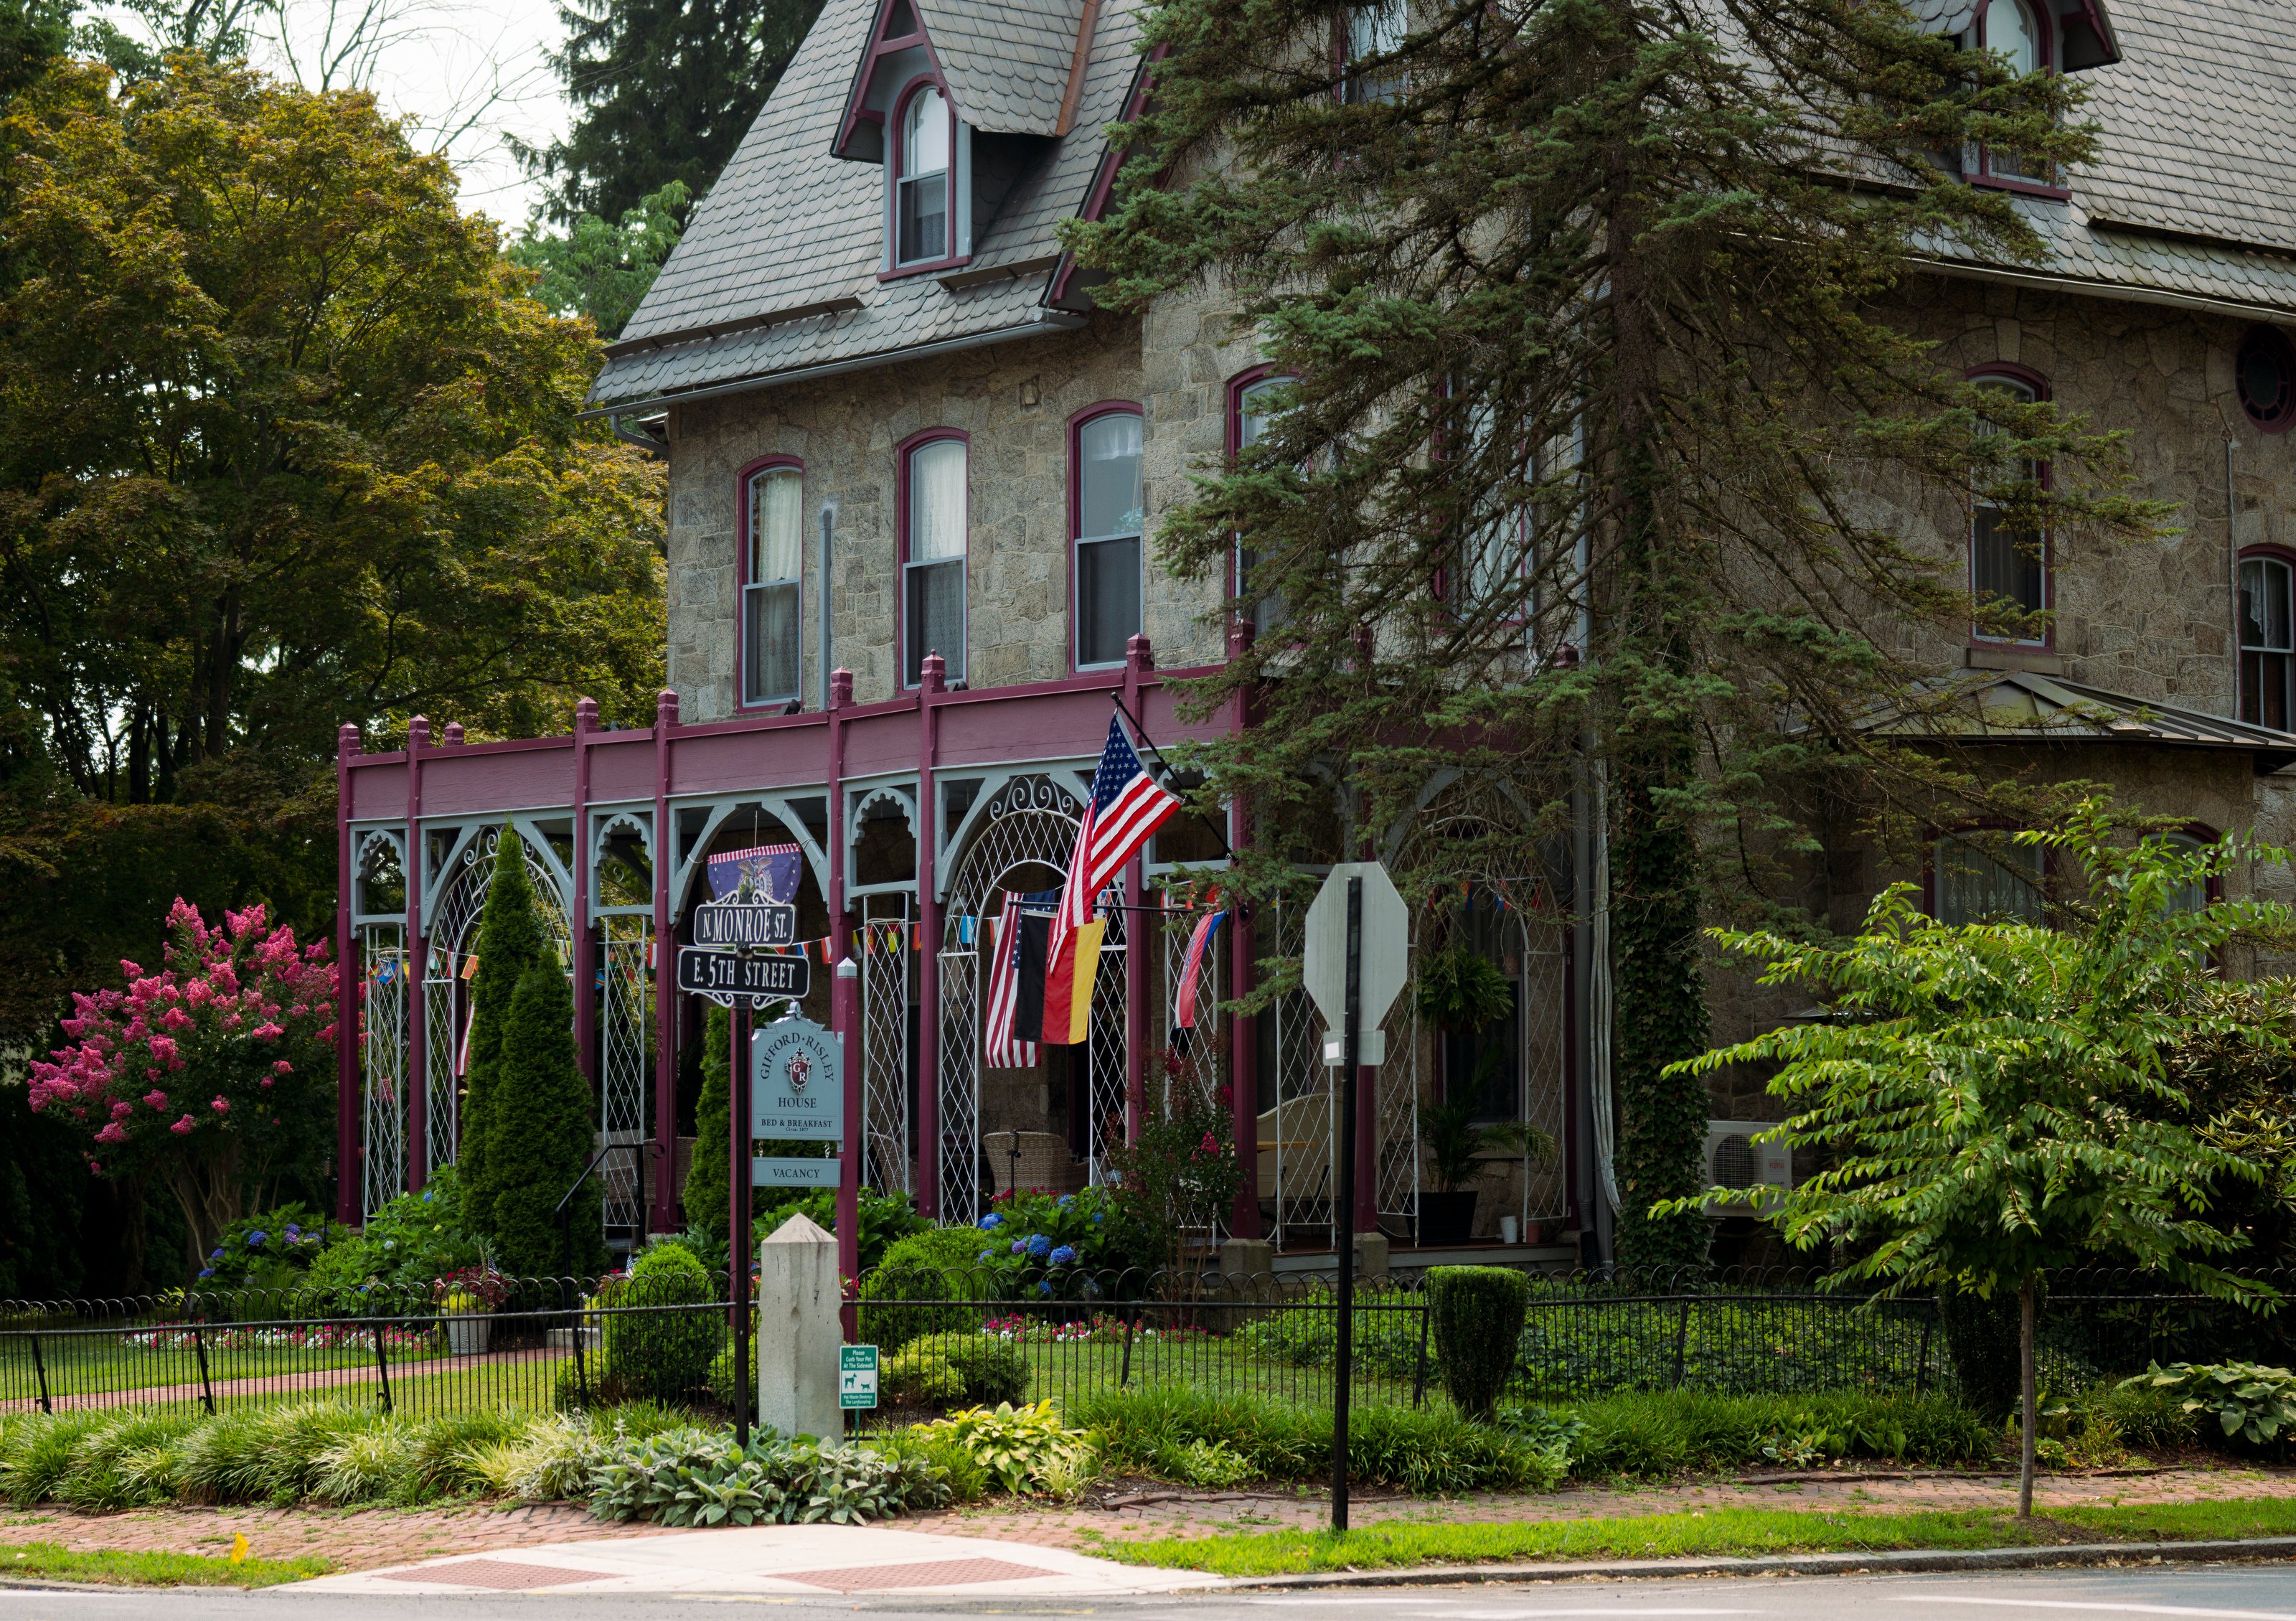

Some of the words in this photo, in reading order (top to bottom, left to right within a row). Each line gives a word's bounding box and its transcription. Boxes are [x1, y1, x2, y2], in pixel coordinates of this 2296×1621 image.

[703, 913, 711, 939] N.
[712, 908, 771, 942] MONROE
[774, 913, 786, 939] ST.
[694, 957, 704, 982] E.
[708, 954, 735, 987] 5TH
[745, 961, 795, 989] STREET
[778, 1096, 817, 1109] HOUSE
[773, 1168, 820, 1178] VACANCY
